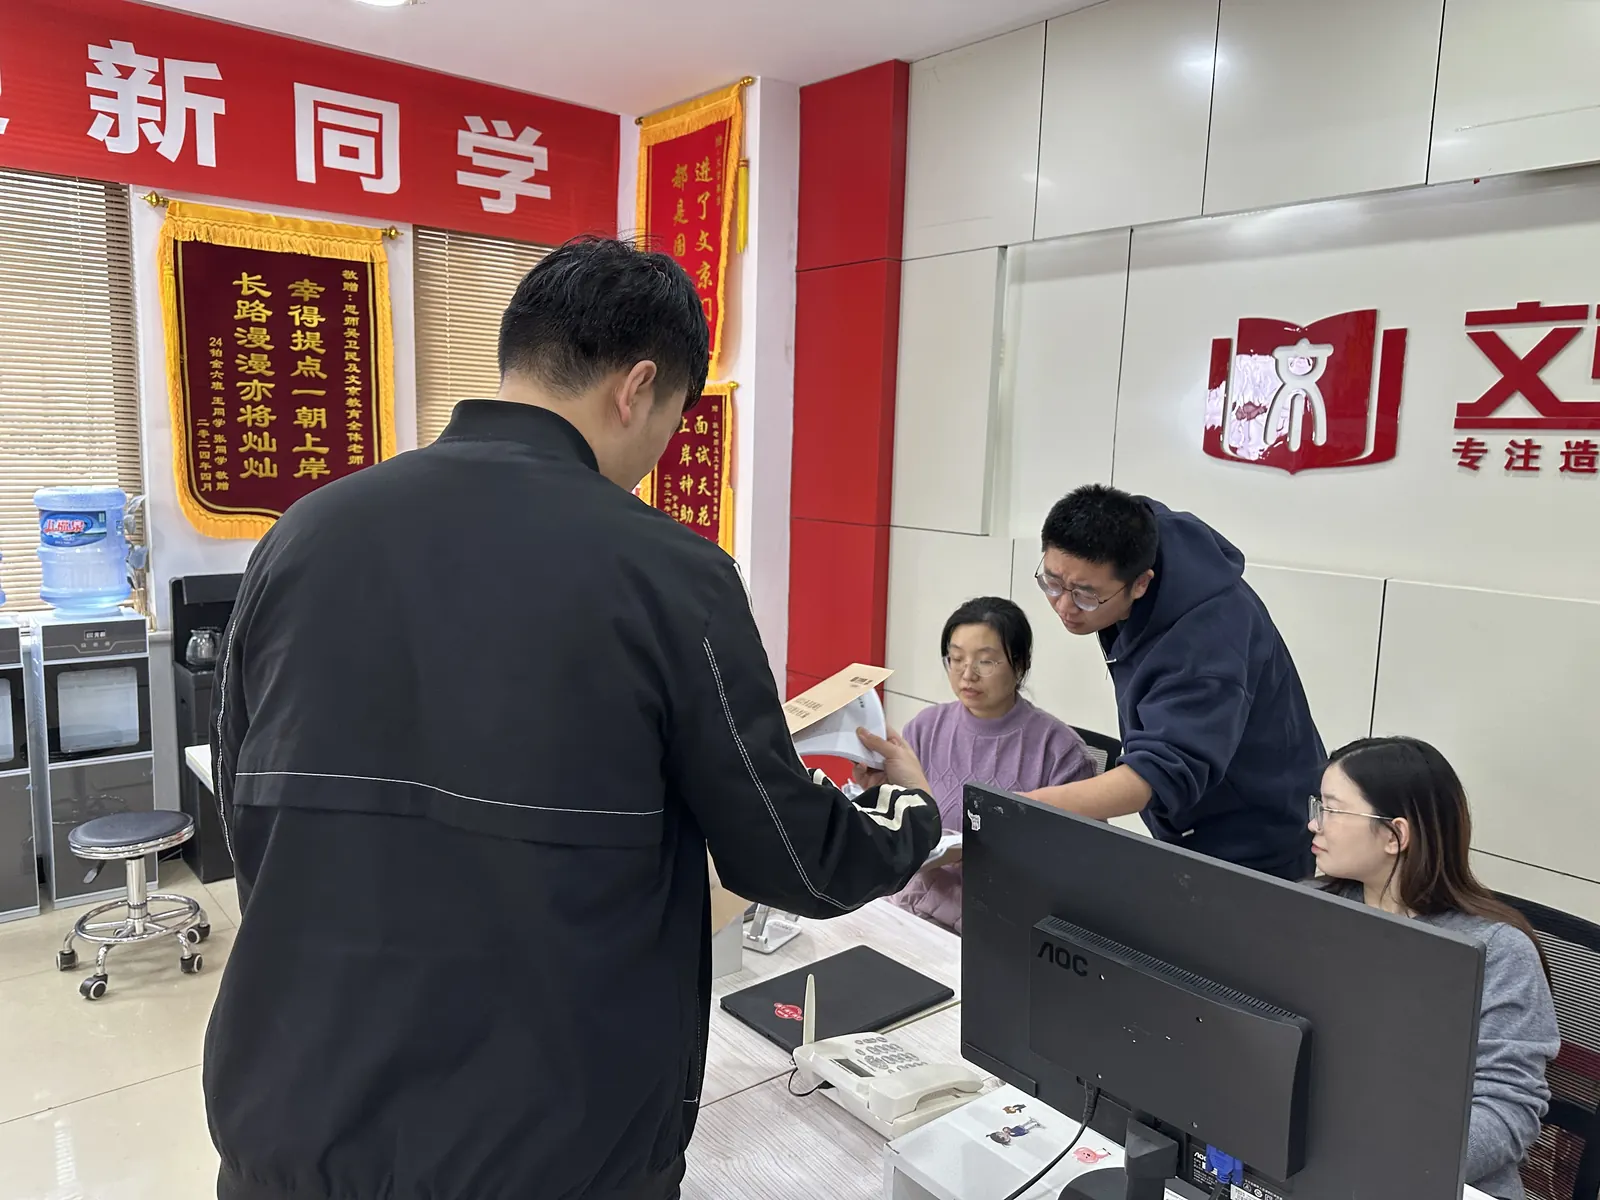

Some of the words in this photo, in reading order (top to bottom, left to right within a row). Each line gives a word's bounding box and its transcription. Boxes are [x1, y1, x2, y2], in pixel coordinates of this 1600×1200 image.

[0, 39, 551, 214] 新同学
[671, 163, 689, 273] 都是国
[232, 271, 278, 479] 长路漫漫亦将灿灿
[287, 278, 331, 480] 幸得提点一朝上岸
[1456, 301, 1600, 417] 文
[196, 418, 213, 492] 二零二四年四月
[679, 416, 694, 525] 上岸神助
[694, 415, 712, 540] 面试天花
[1452, 437, 1600, 473] 专注造
[1037, 941, 1089, 977] AOC
